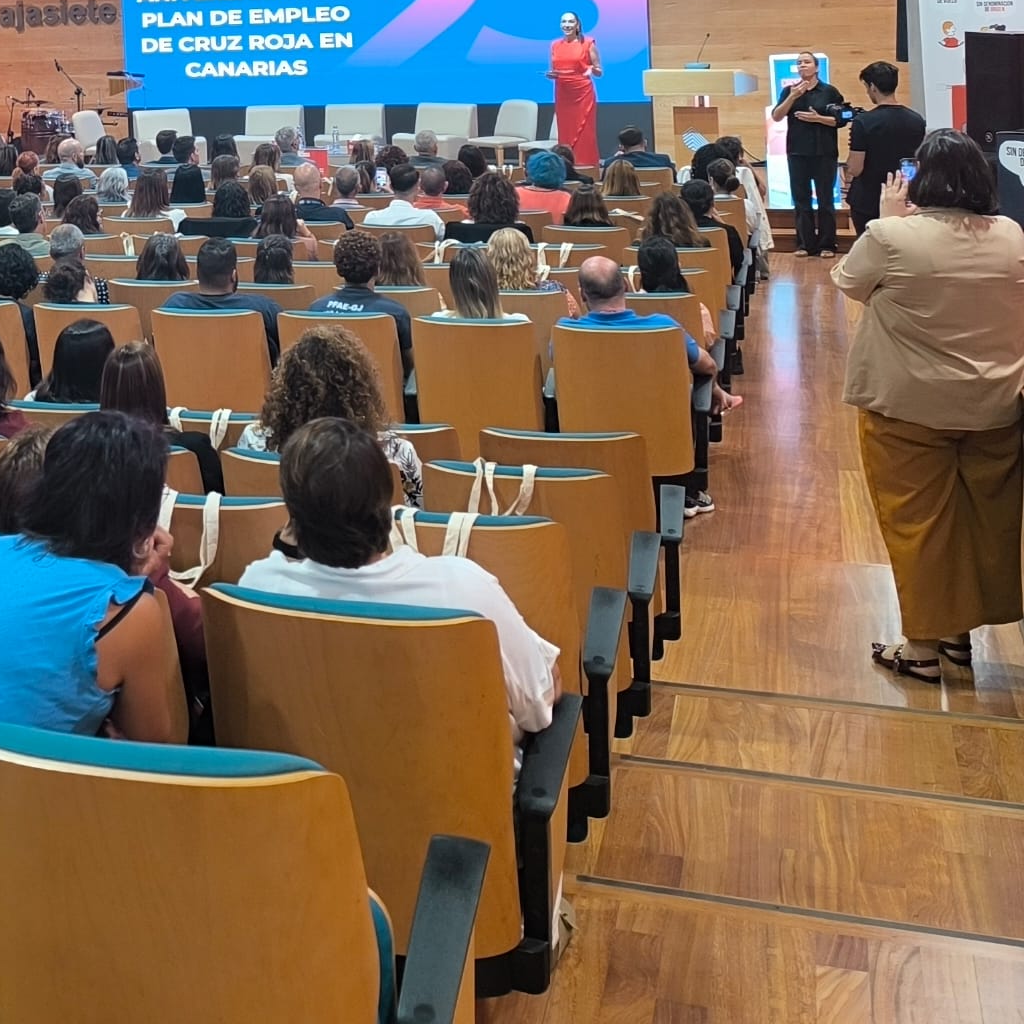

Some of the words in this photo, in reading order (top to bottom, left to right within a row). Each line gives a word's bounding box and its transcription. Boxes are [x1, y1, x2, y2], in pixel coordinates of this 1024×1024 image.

[142, 11, 203, 28] PLAN
[209, 10, 243, 26] DE
[249, 6, 350, 25] EMPLEO
[141, 37, 173, 53] DE
[178, 35, 243, 53] CRUZ
[249, 33, 314, 51] ROJA
[319, 32, 353, 49] EN
[185, 59, 308, 78] CANARIAS
